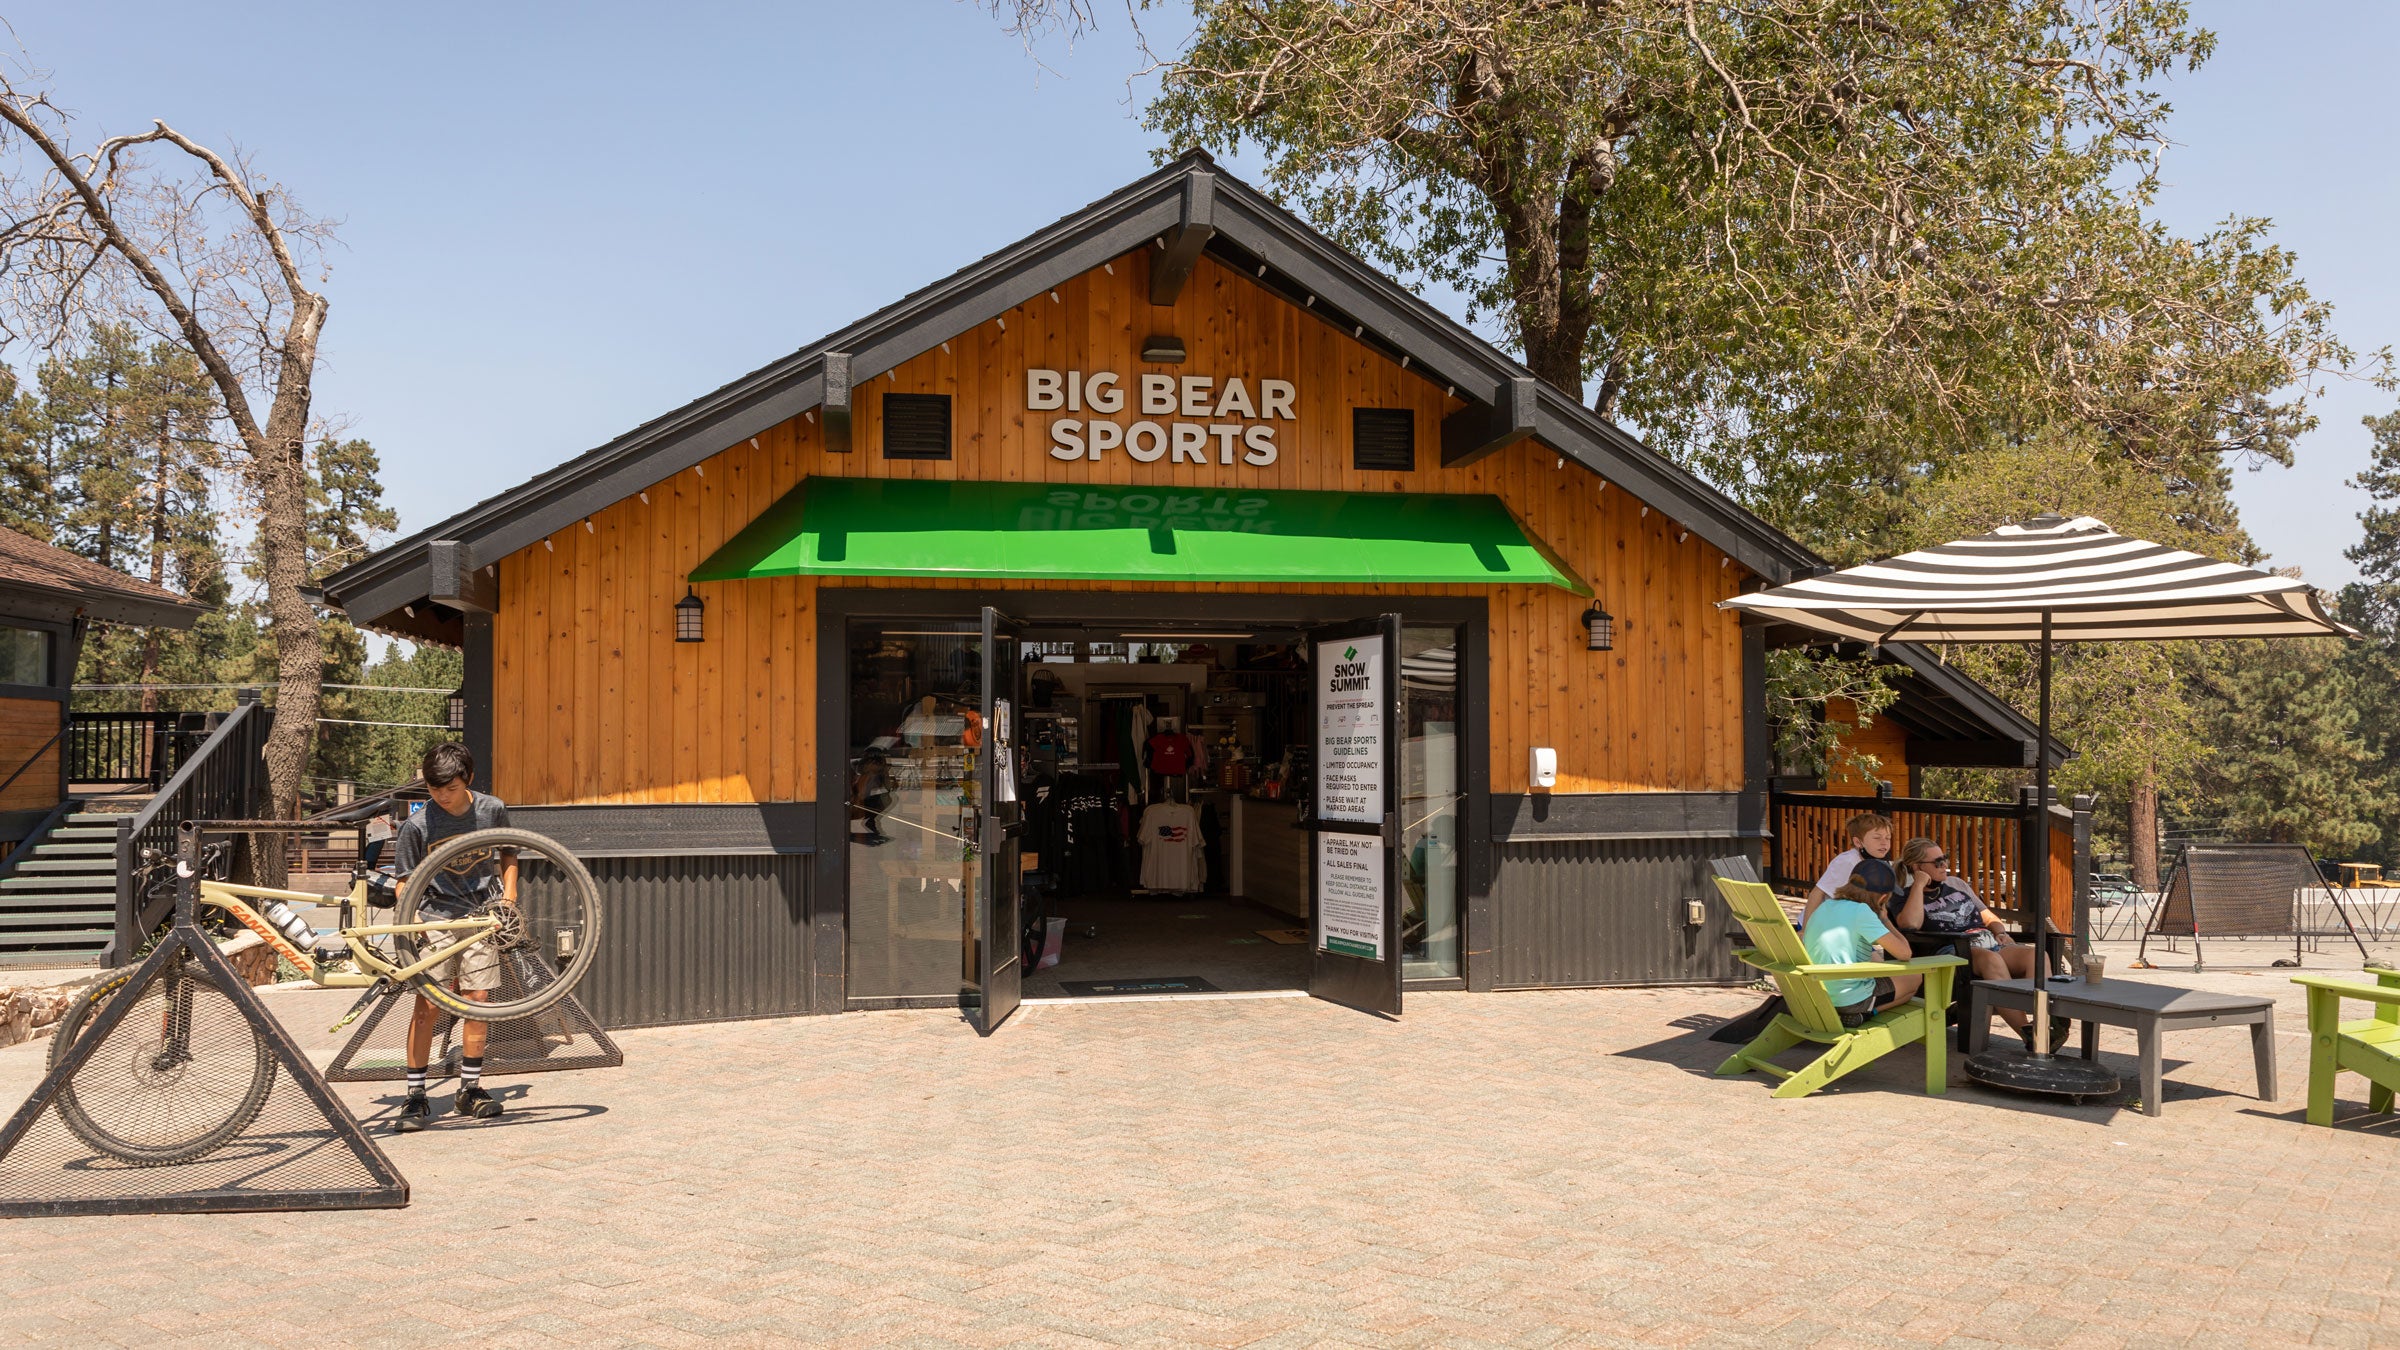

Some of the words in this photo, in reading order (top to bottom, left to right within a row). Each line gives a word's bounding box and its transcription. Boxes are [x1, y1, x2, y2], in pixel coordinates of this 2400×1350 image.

[1027, 368, 1124, 414] BIG
[1141, 373, 1297, 420] BEAR
[1050, 418, 1278, 466] SPORTS
[1334, 662, 1366, 678] SNOW
[1330, 676, 1370, 692] SUMMIT
[1356, 701, 1374, 709] SPREAD
[1325, 737, 1335, 745] BIG
[1336, 737, 1352, 745] BEAR
[1353, 736, 1377, 744] SPORTS
[1333, 747, 1369, 756] GUIDELINES
[1326, 761, 1345, 769] LIMITED
[1346, 761, 1379, 769] OCCUPANCY
[1346, 796, 1359, 804] WAIT
[1360, 797, 1367, 805] AT
[1348, 805, 1365, 813] AREAS
[1326, 839, 1348, 847] APPAREL
[1349, 840, 1361, 848] MAY
[1361, 841, 1373, 849] NOT
[1326, 846, 1333, 854] BE
[1334, 847, 1349, 855] TRIED
[1350, 848, 1358, 856] ON
[1337, 860, 1352, 869] SALES
[1353, 862, 1369, 871] FINAL
[1330, 873, 1345, 881] PLEASE
[1345, 875, 1366, 883] REMEMBER
[1349, 883, 1369, 891] DISTANCE
[1328, 887, 1344, 895] FOLLOW
[1352, 891, 1375, 900] GUIDELINES
[230, 905, 278, 943] SANTA
[273, 943, 313, 971] CRUZ
[1325, 925, 1340, 933] THANK
[1350, 929, 1359, 937] FOR
[1360, 931, 1379, 941] VISITING
